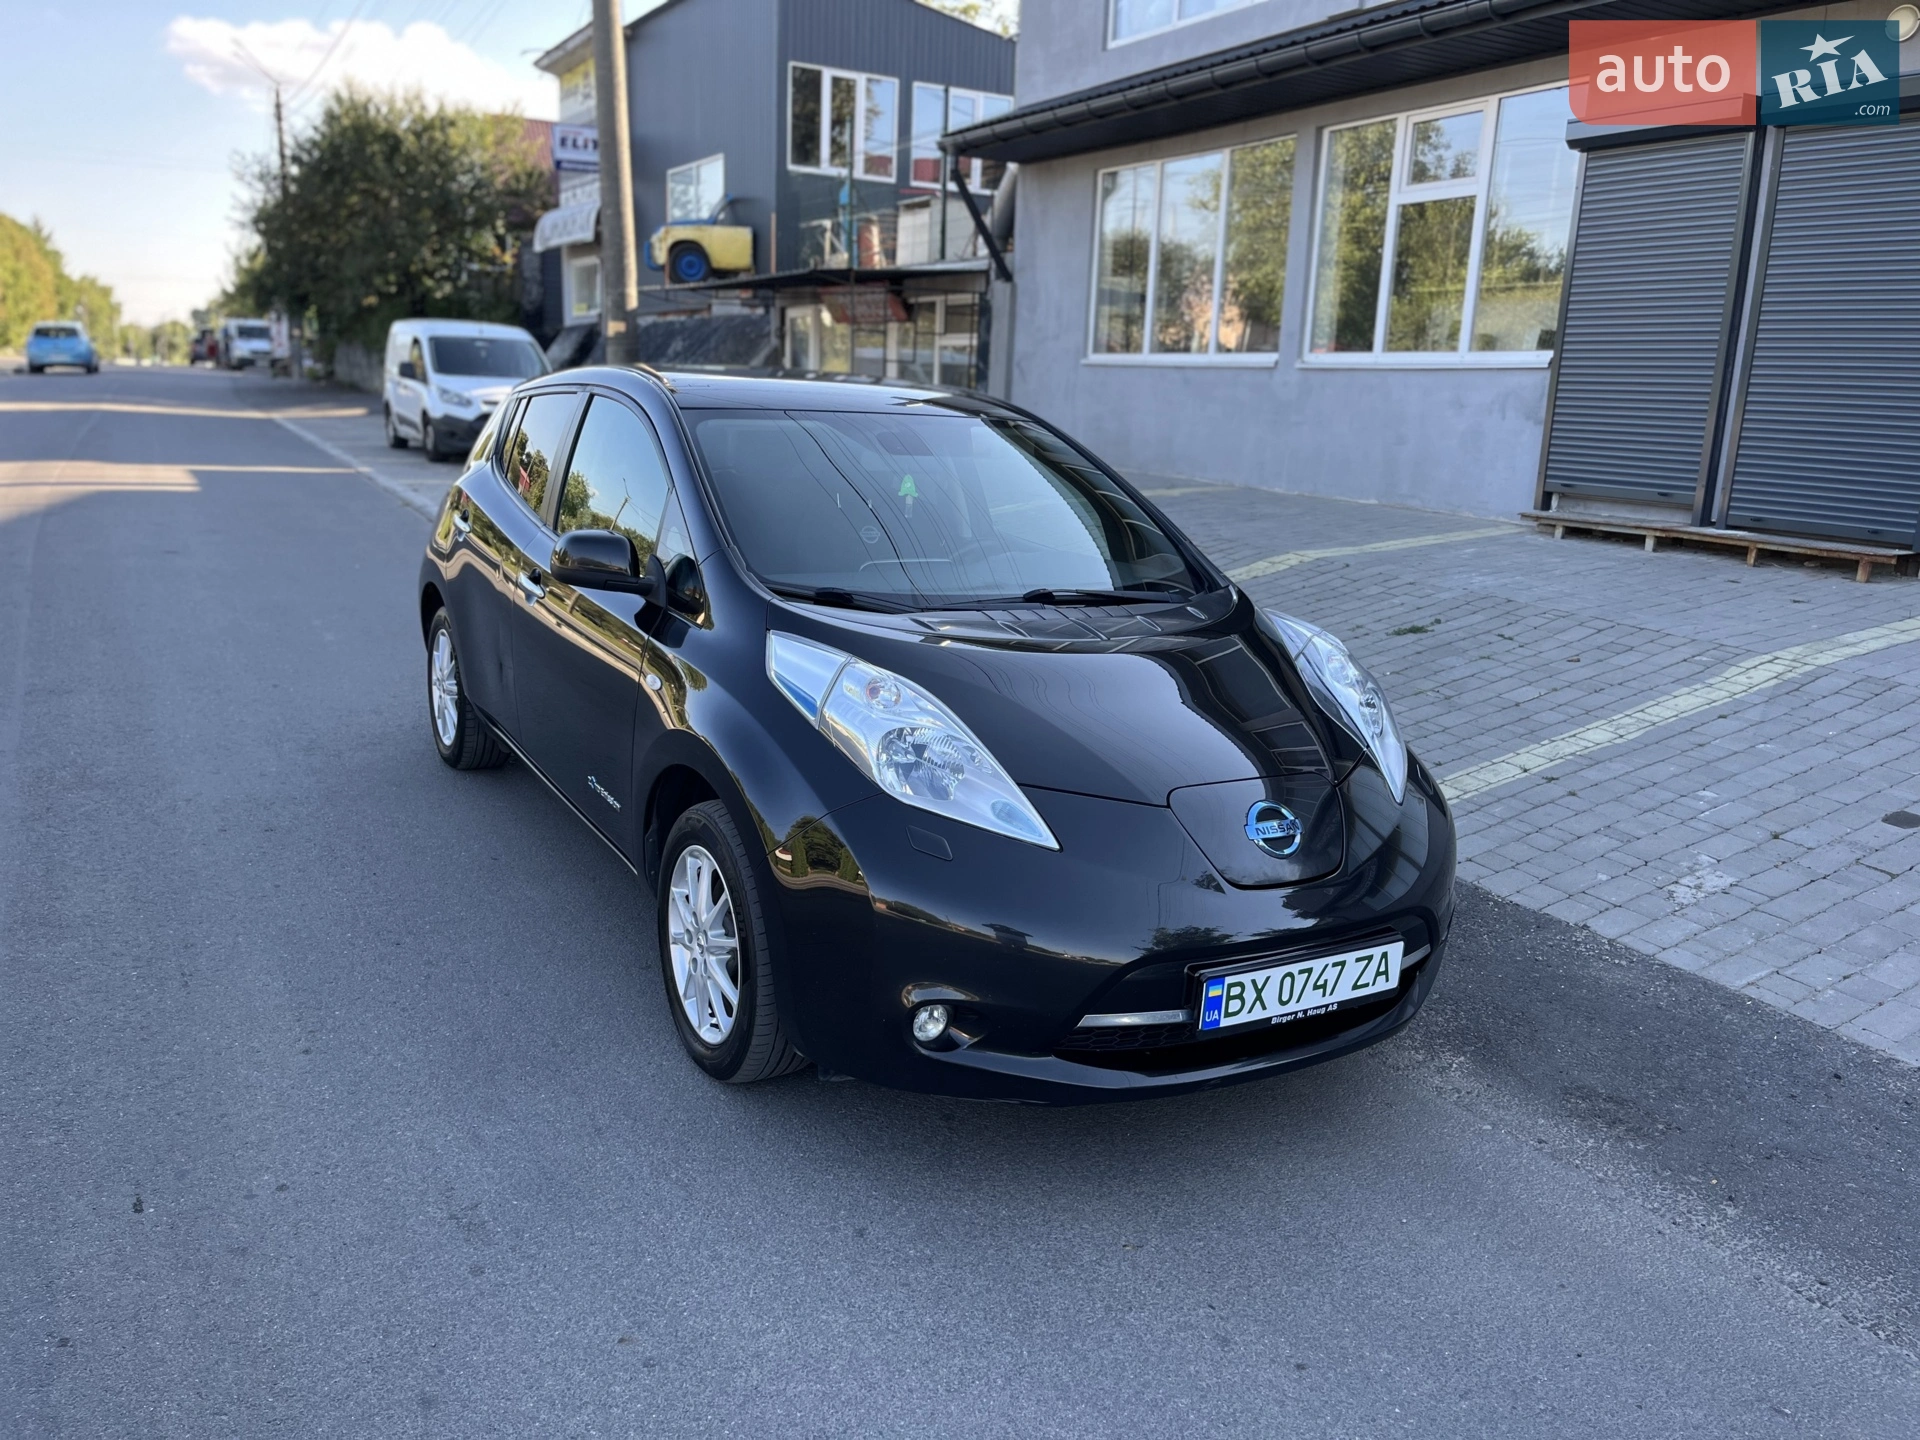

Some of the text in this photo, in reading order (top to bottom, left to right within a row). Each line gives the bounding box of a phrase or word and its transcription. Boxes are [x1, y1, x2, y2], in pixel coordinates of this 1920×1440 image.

[1255, 820, 1300, 836] NISSAN
[1223, 951, 1390, 1019] BX 0747 ZA
[1205, 1010, 1219, 1022] UA
[1271, 1014, 1295, 1025] Birger
[1327, 1003, 1338, 1011] AS
